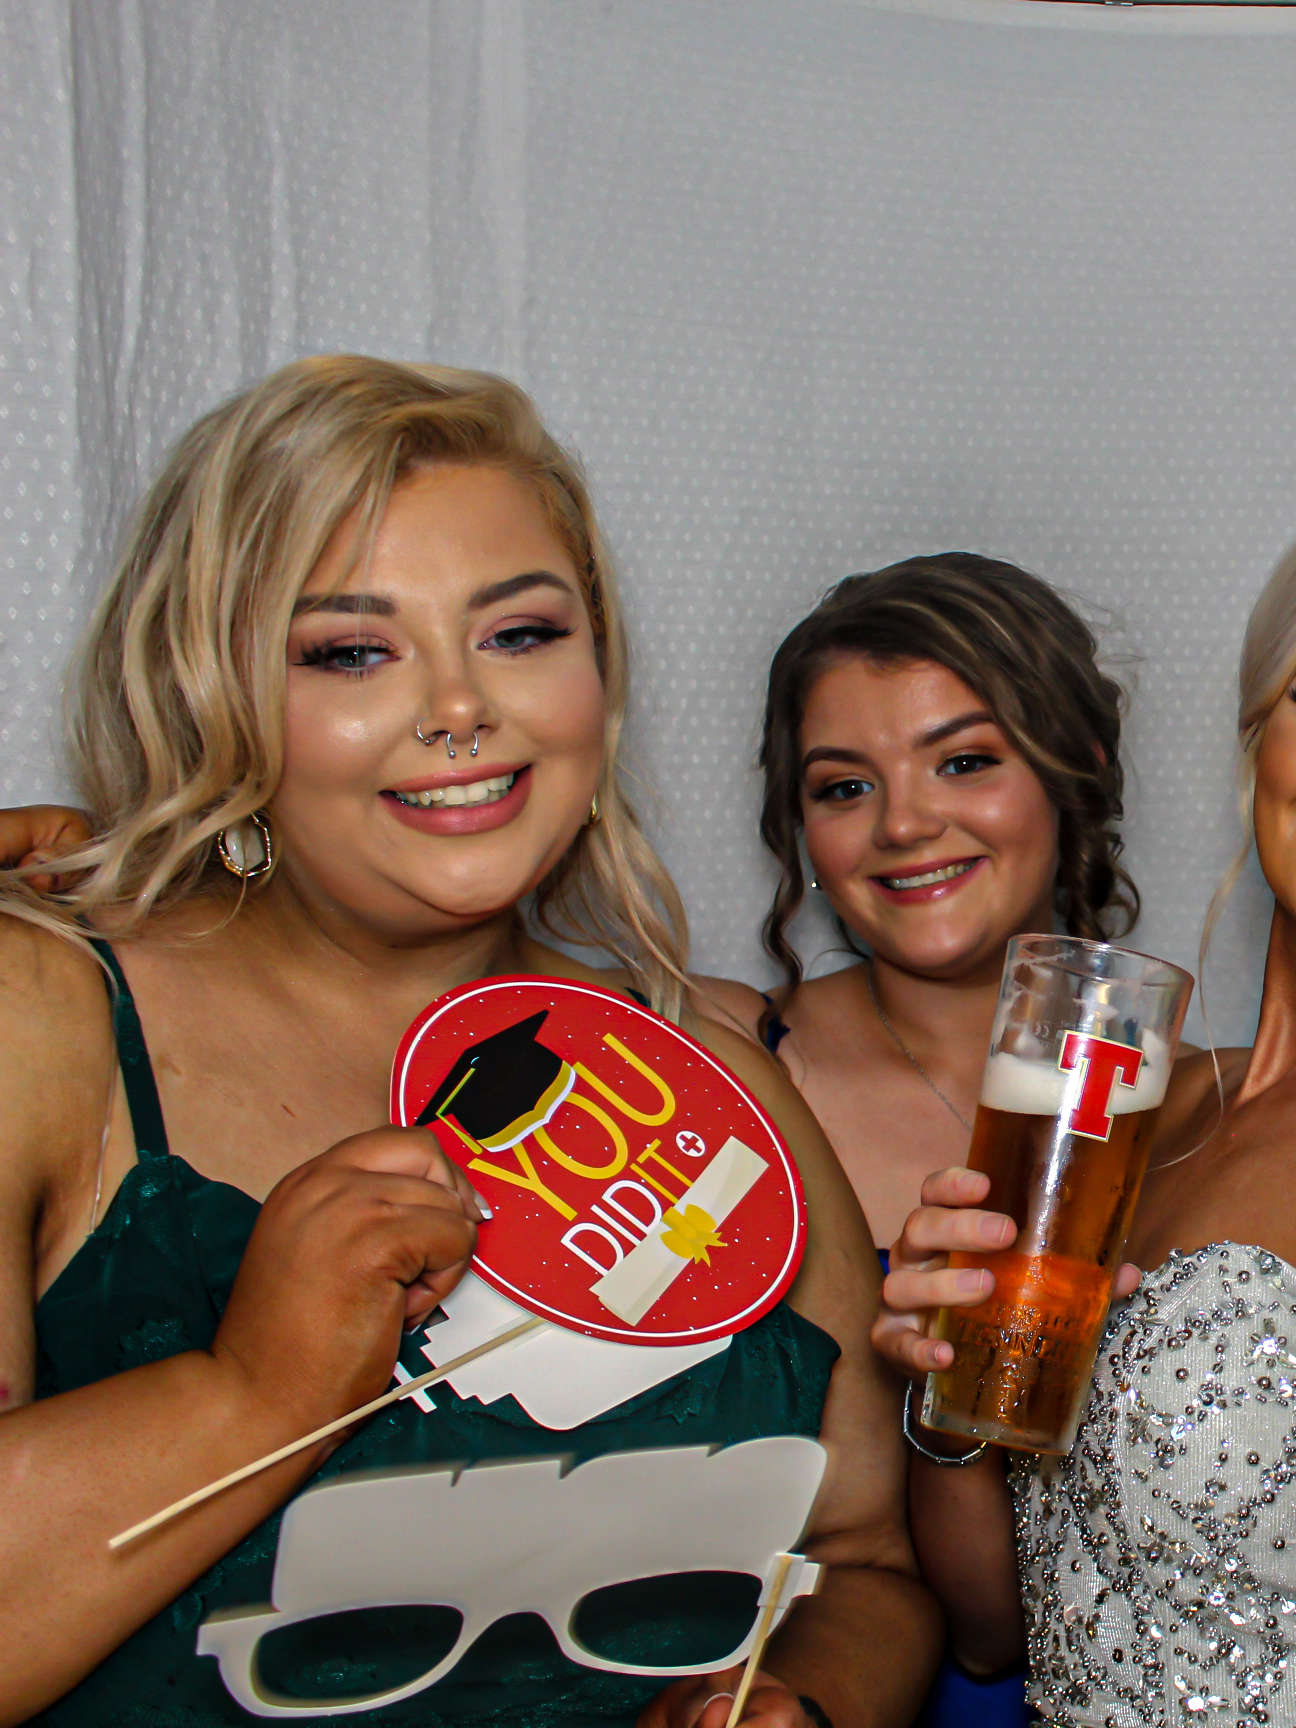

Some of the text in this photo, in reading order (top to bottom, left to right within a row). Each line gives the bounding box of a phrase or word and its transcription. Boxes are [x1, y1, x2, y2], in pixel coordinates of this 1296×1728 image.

[467, 1032, 676, 1222] YOU
[1057, 1029, 1143, 1142] T
[560, 1179, 662, 1277] DID
